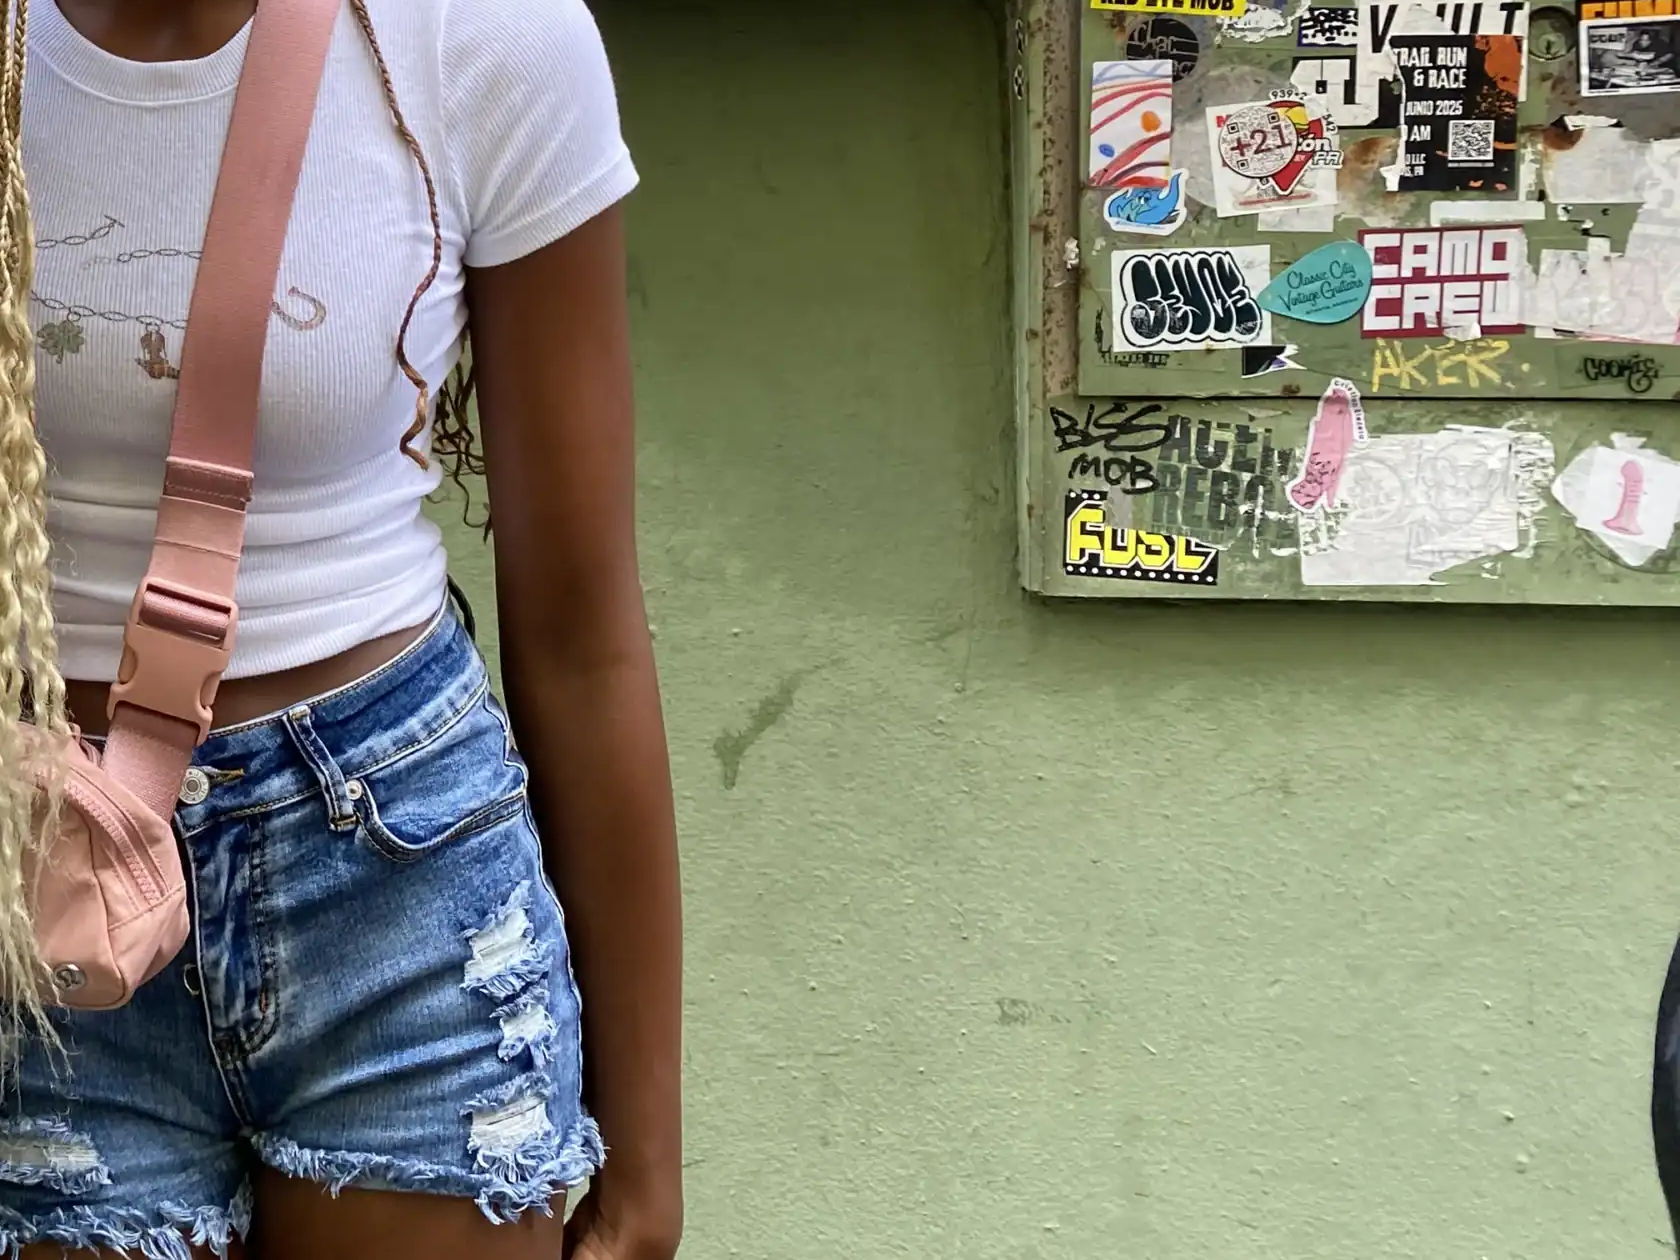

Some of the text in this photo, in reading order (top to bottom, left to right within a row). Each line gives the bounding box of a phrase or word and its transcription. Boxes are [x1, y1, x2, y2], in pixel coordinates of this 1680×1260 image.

[1436, 46, 1468, 67] RUN
[1413, 68, 1468, 88] & RACE
[1435, 100, 1463, 115] 2025
[1410, 124, 1432, 142] AM
[1362, 230, 1519, 280] CAMO
[1287, 260, 1356, 289] Classic City
[1279, 290, 1321, 311] Vintage
[1320, 278, 1364, 299] Guitars
[1363, 280, 1520, 332] CREW
[1372, 337, 1510, 393] AKER
[1068, 453, 1160, 495] MOB
